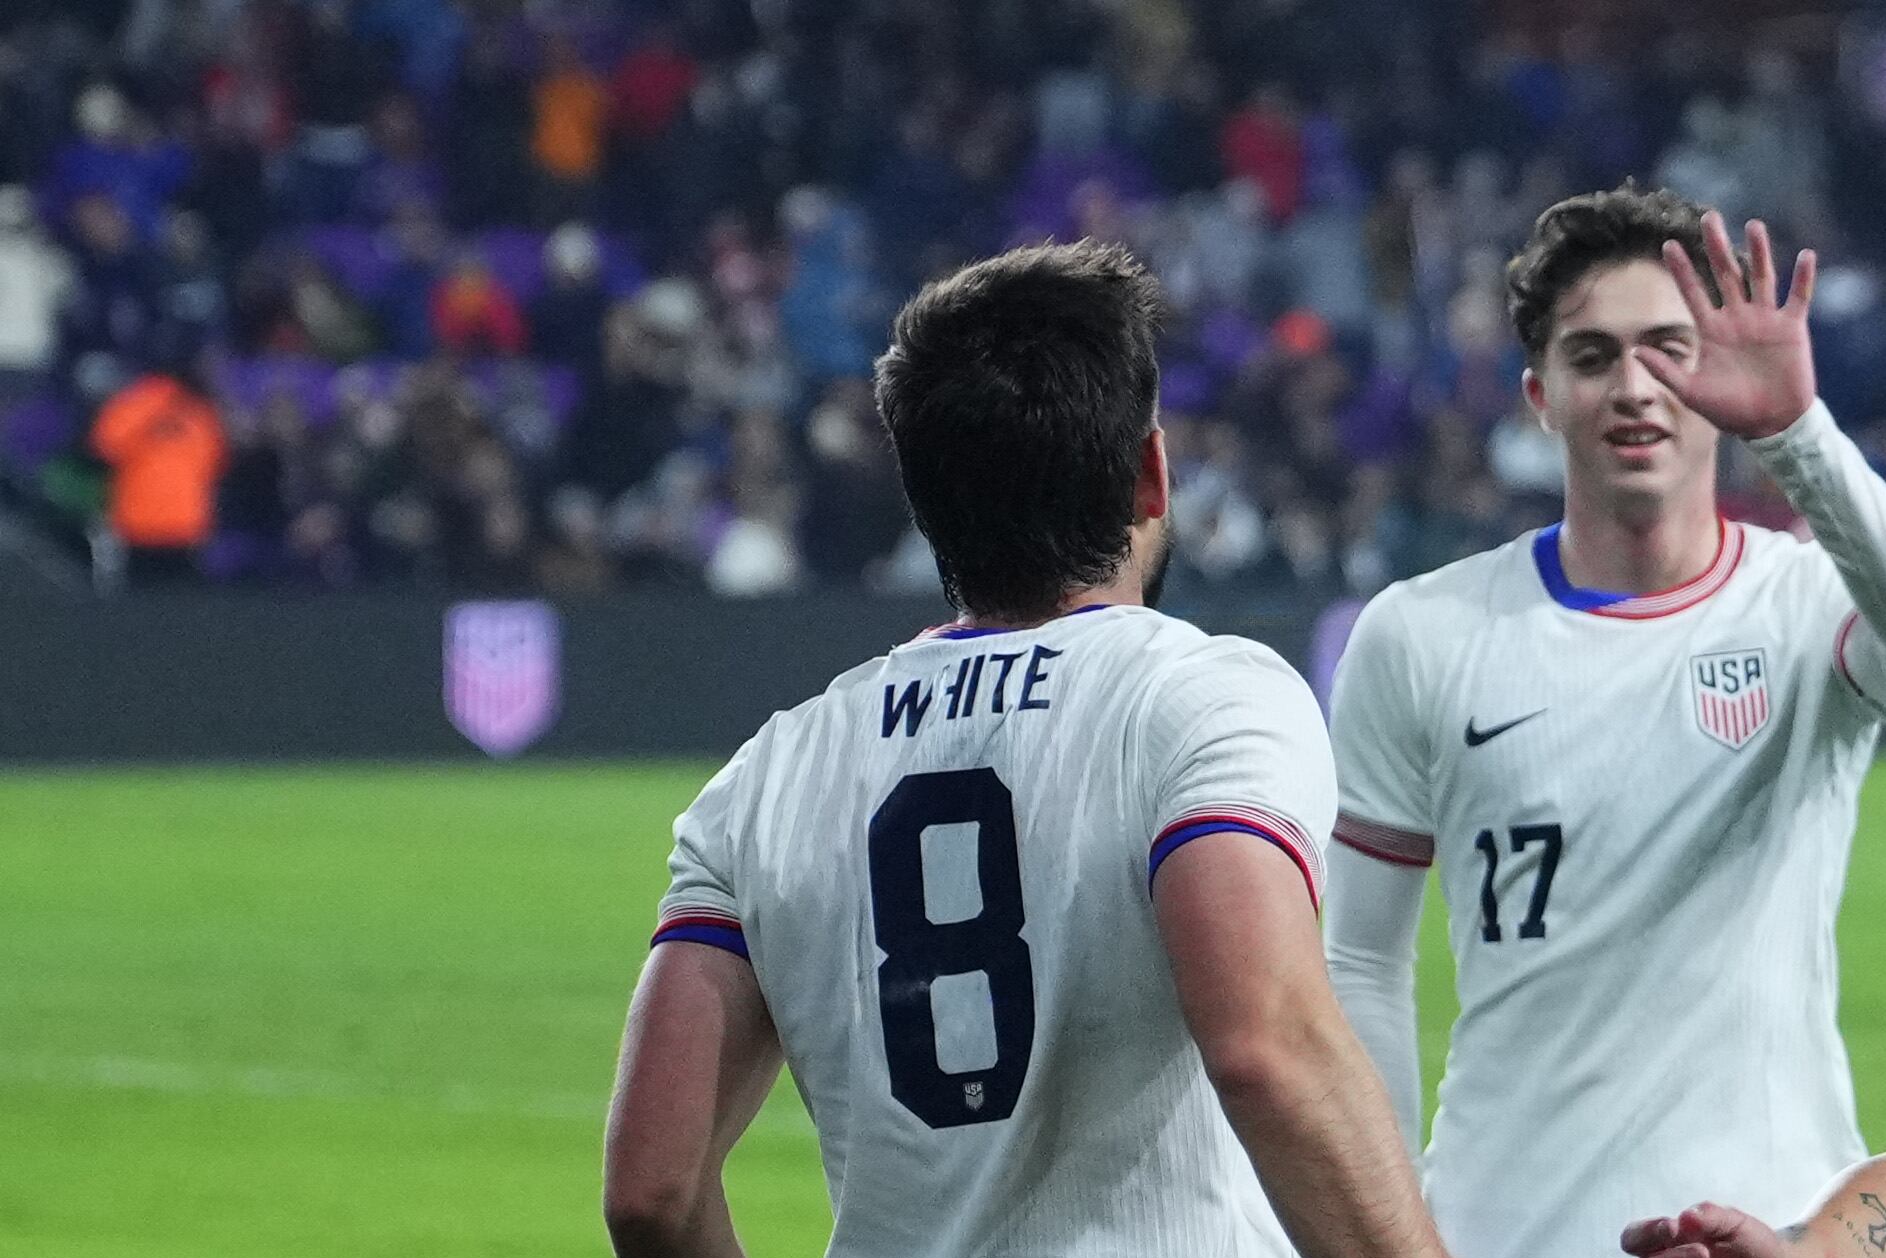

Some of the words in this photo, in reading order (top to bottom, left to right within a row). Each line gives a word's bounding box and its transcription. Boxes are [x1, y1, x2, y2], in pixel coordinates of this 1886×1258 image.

[881, 644, 1064, 738] WHITE
[1698, 655, 1763, 694] USA
[1474, 823, 1563, 942] 17
[867, 766, 1037, 1130] 8
[964, 1083, 983, 1097] USA
